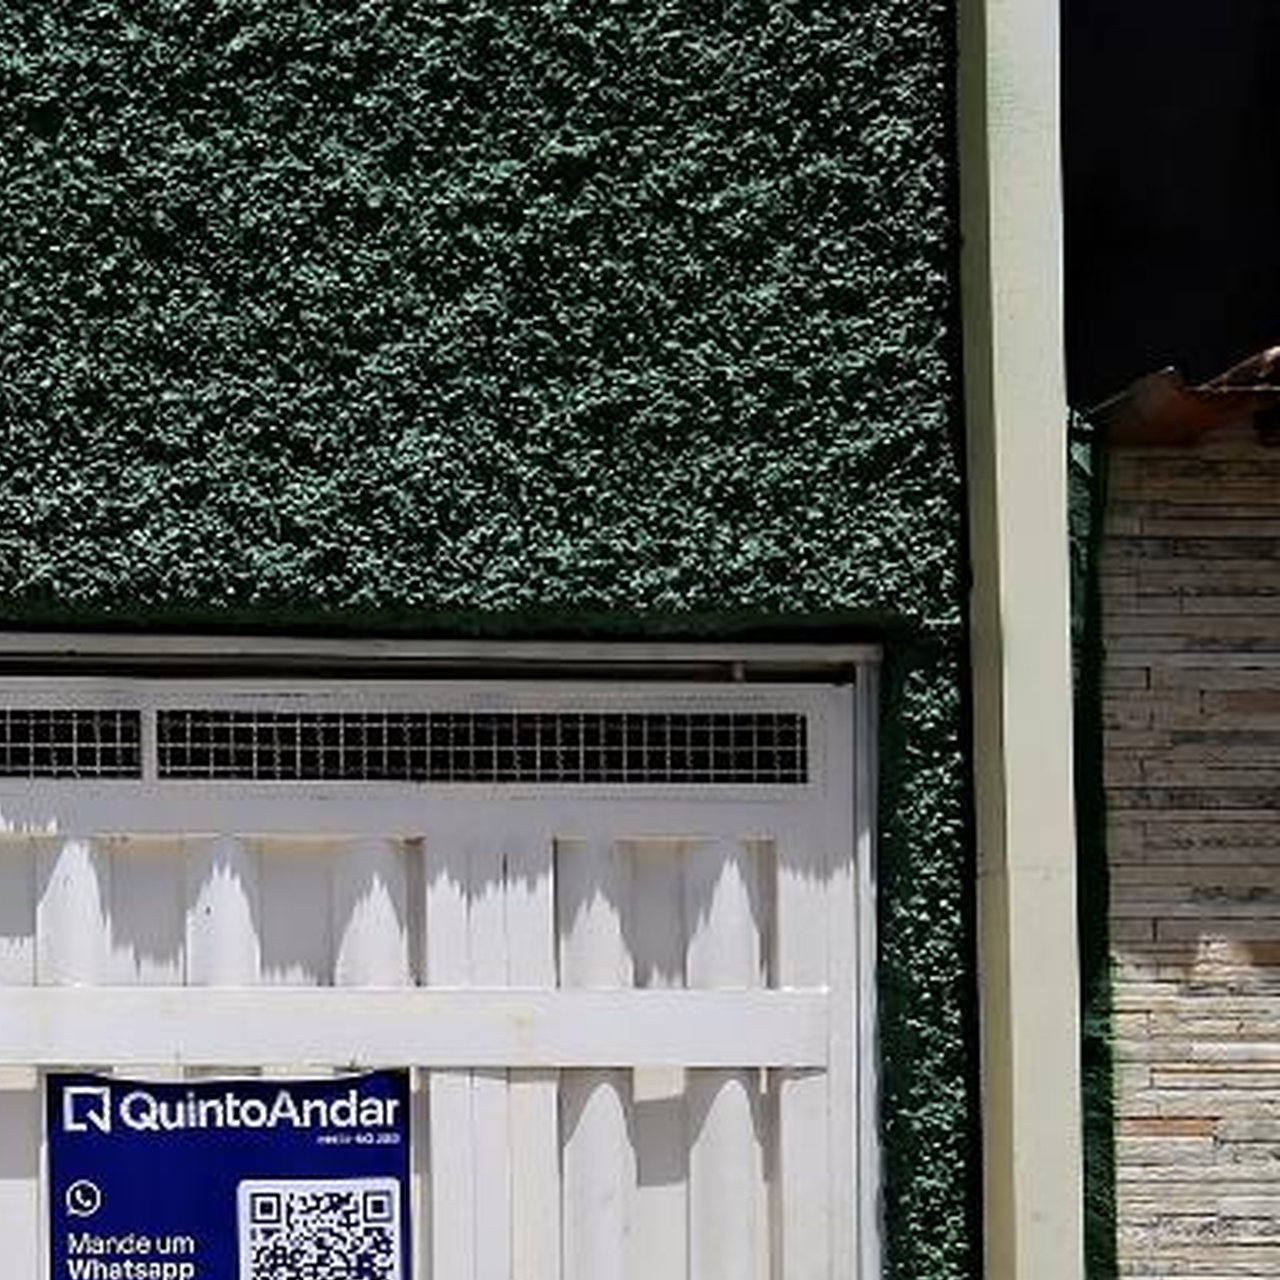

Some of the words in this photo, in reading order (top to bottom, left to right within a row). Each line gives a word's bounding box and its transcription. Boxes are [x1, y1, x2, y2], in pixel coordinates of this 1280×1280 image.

[119, 1089, 400, 1131] QuintoAndar
[68, 1232, 151, 1254] Mande
[156, 1235, 195, 1254] um
